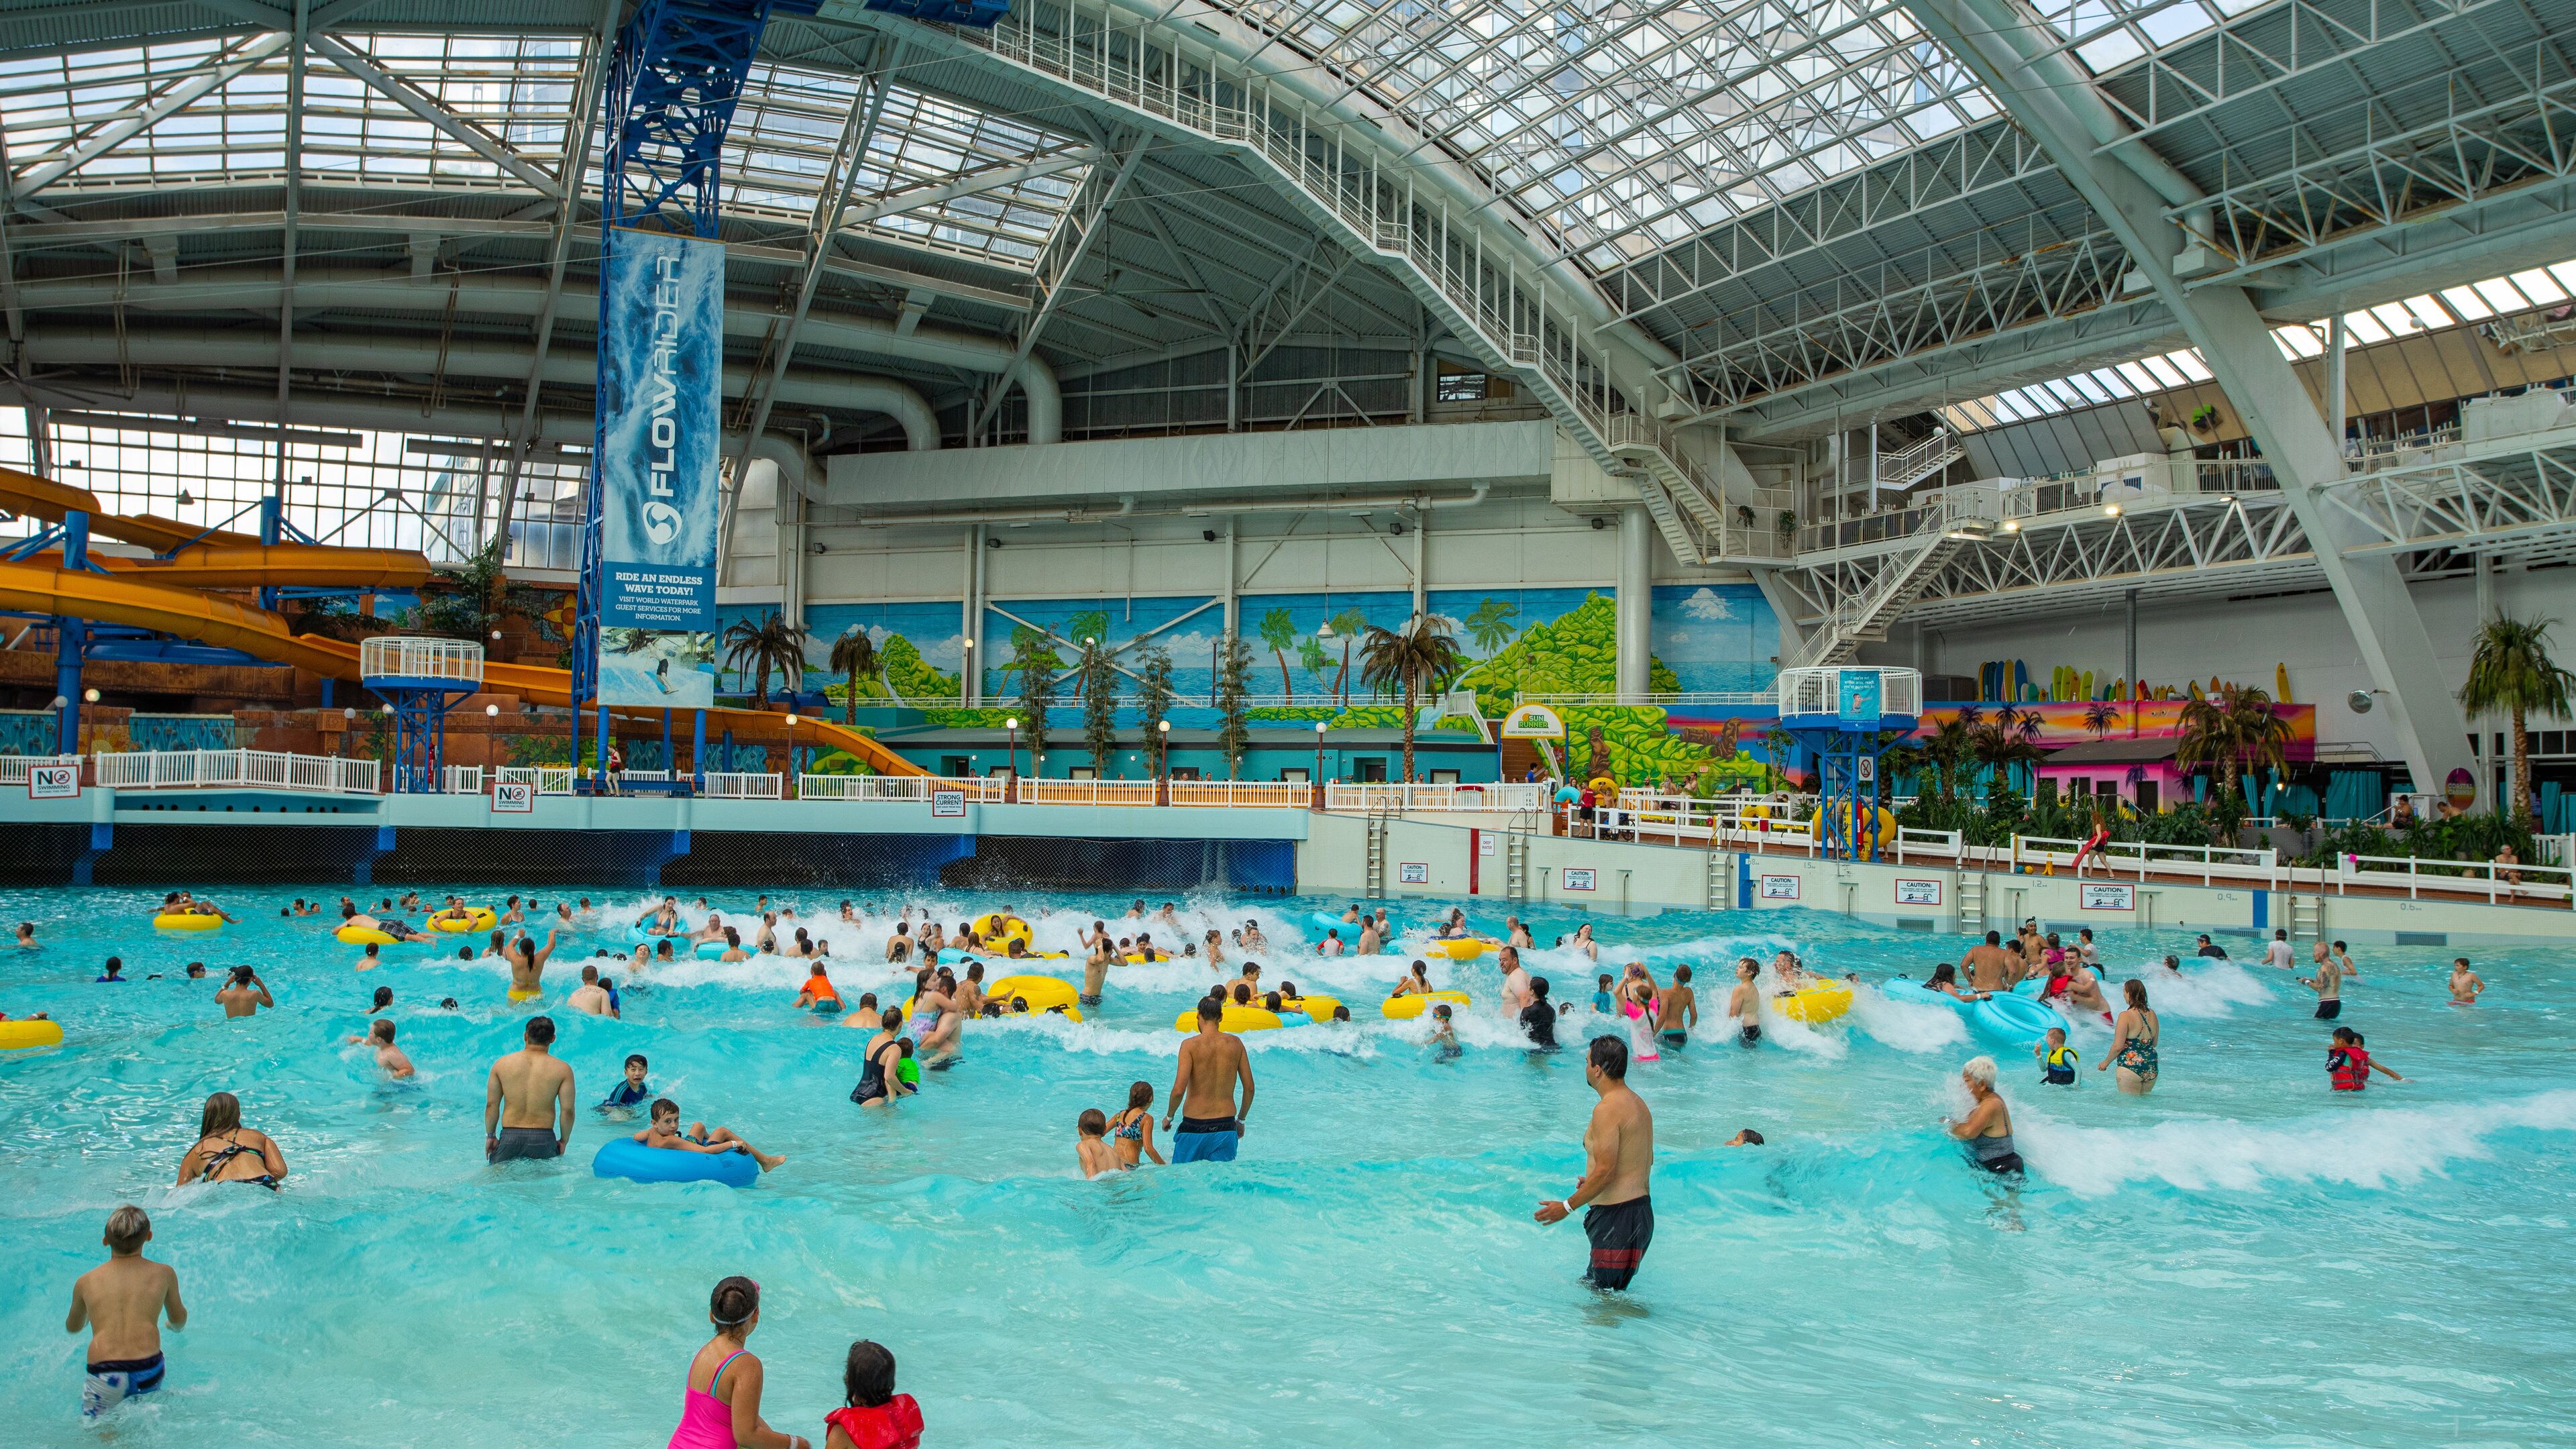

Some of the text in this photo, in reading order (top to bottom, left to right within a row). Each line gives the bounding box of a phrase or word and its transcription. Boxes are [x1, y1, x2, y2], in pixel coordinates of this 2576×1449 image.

[651, 256, 680, 497] FLOWRIDER
[615, 572, 702, 585] RIDE AN ENDLESS
[625, 584, 693, 596] WAVE TODAY!
[635, 613, 681, 621] INFORMATION.
